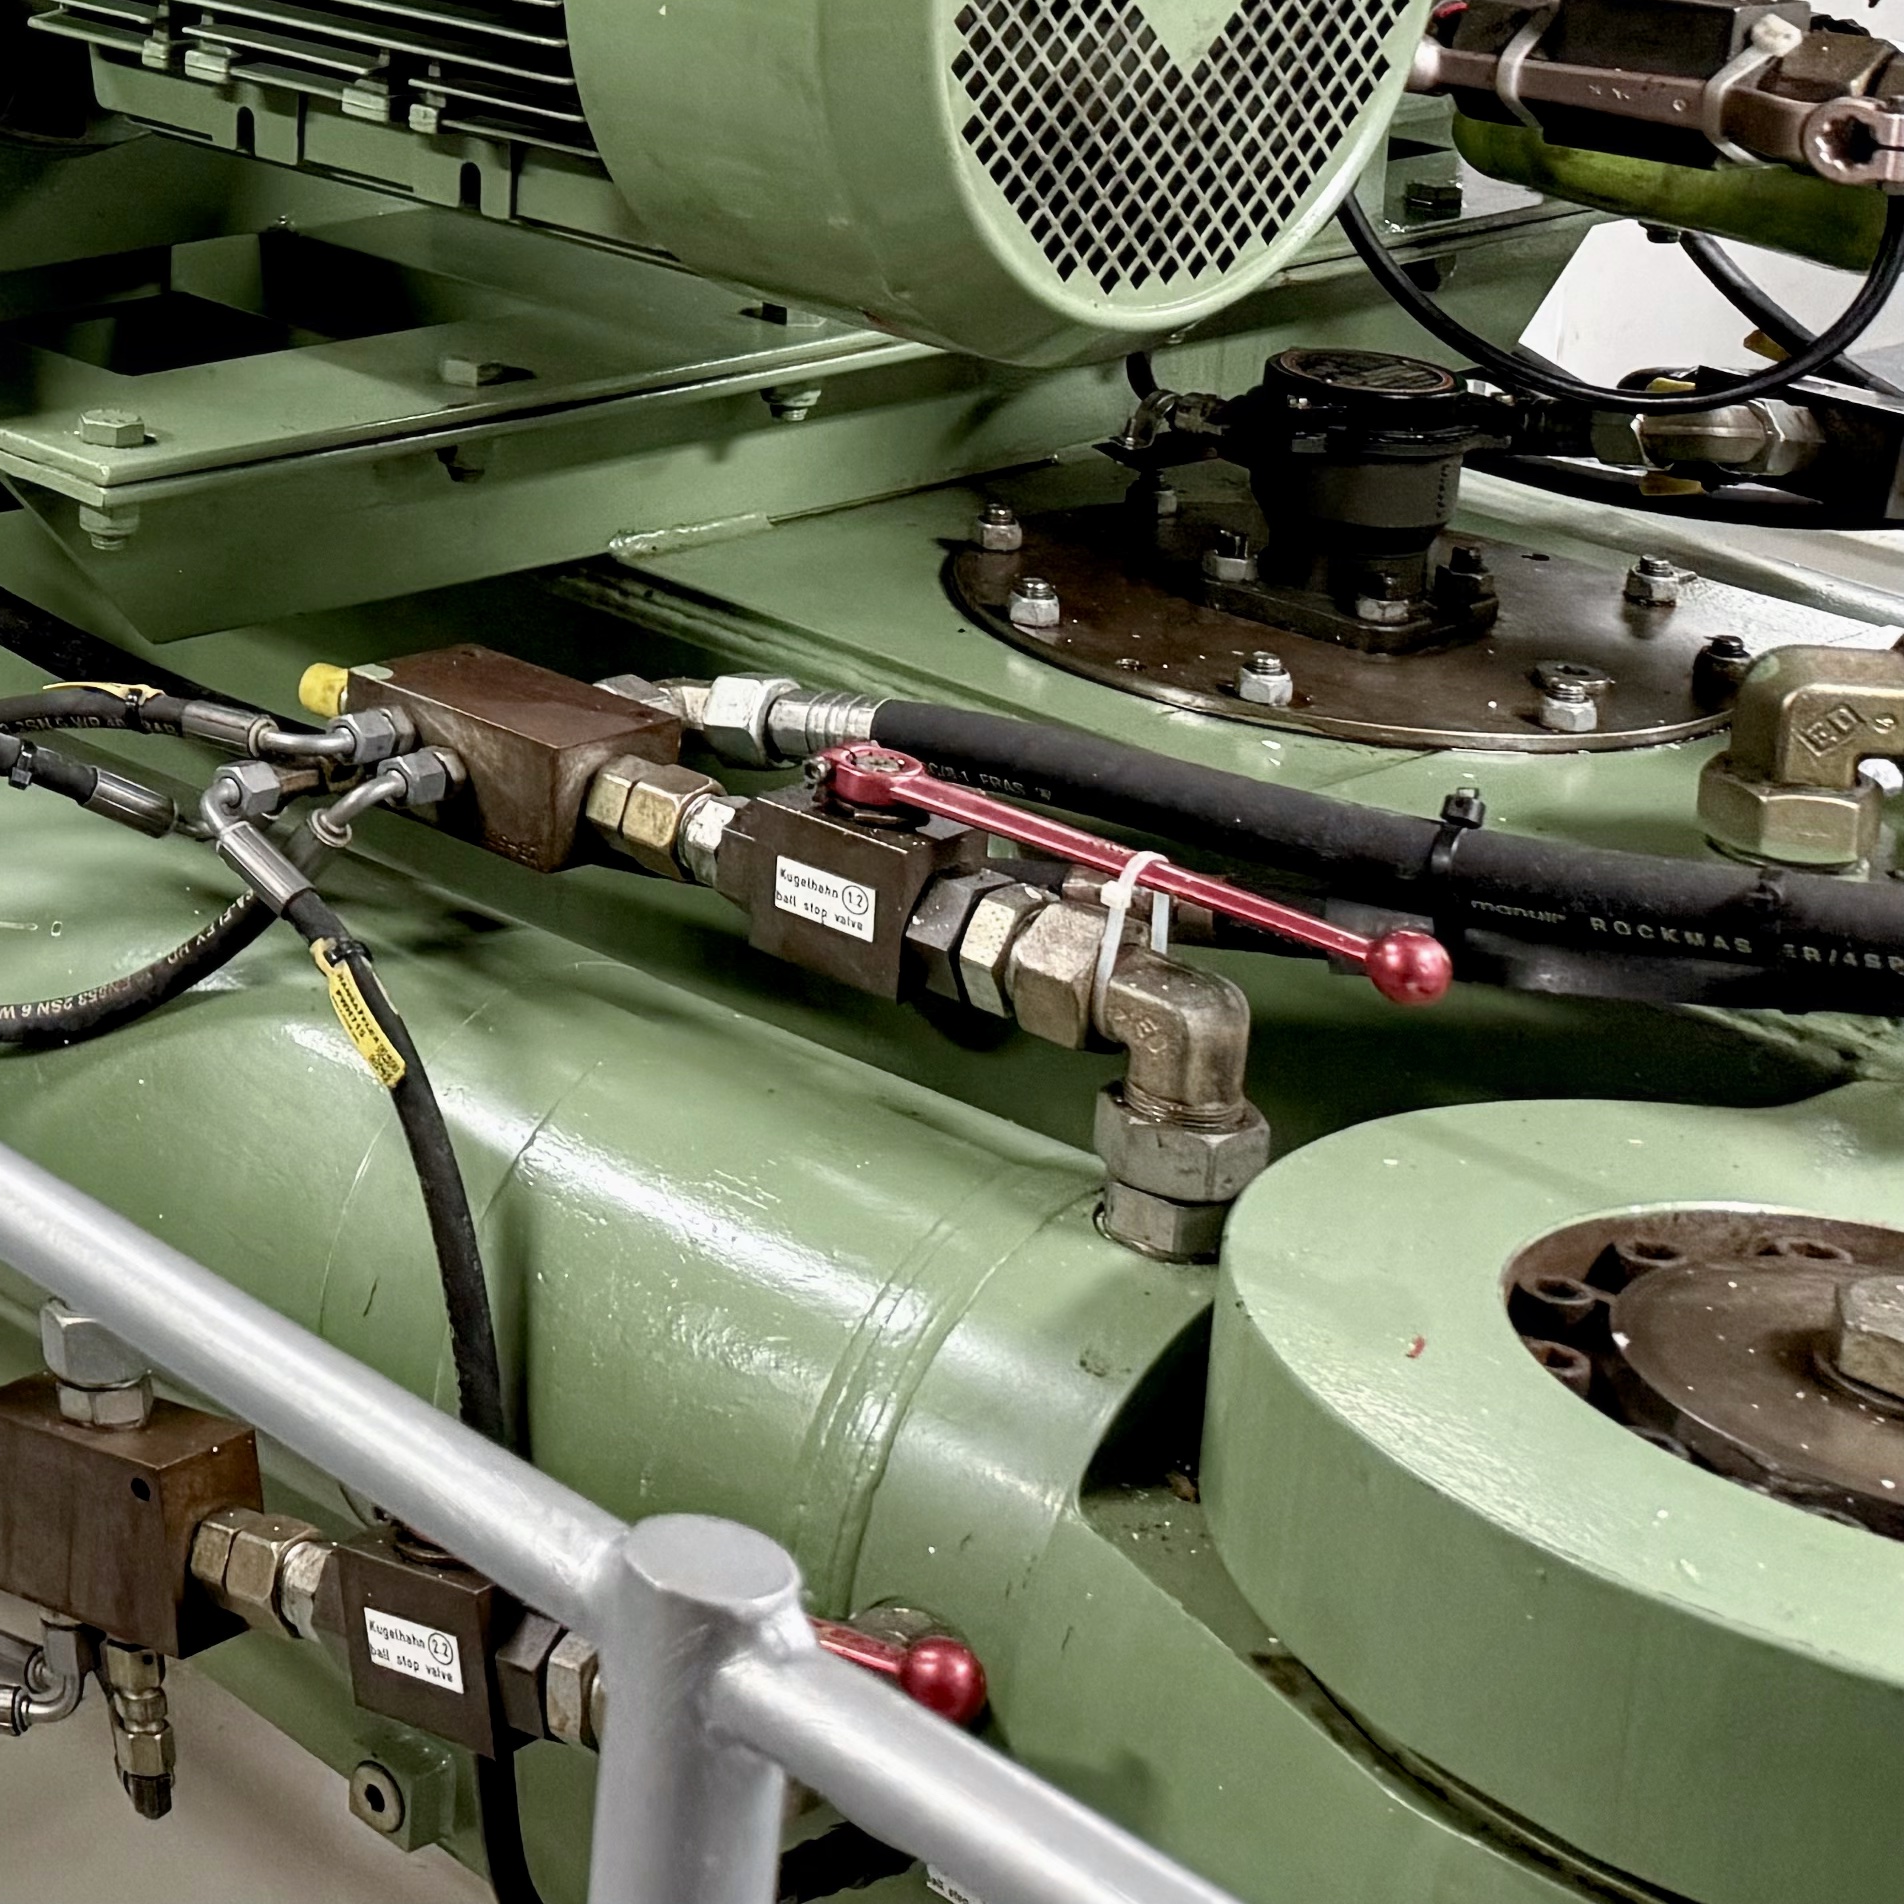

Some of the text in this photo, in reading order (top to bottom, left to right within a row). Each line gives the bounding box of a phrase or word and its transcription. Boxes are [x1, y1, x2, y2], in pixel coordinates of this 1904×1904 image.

[979, 773, 1027, 795] FRAS
[780, 867, 839, 899] Kugelhahn
[775, 890, 863, 932] ball stop valve
[36, 996, 74, 1017] 2SN
[368, 1619, 426, 1649] Kugelhahn
[370, 1643, 454, 1683] ball stop valve
